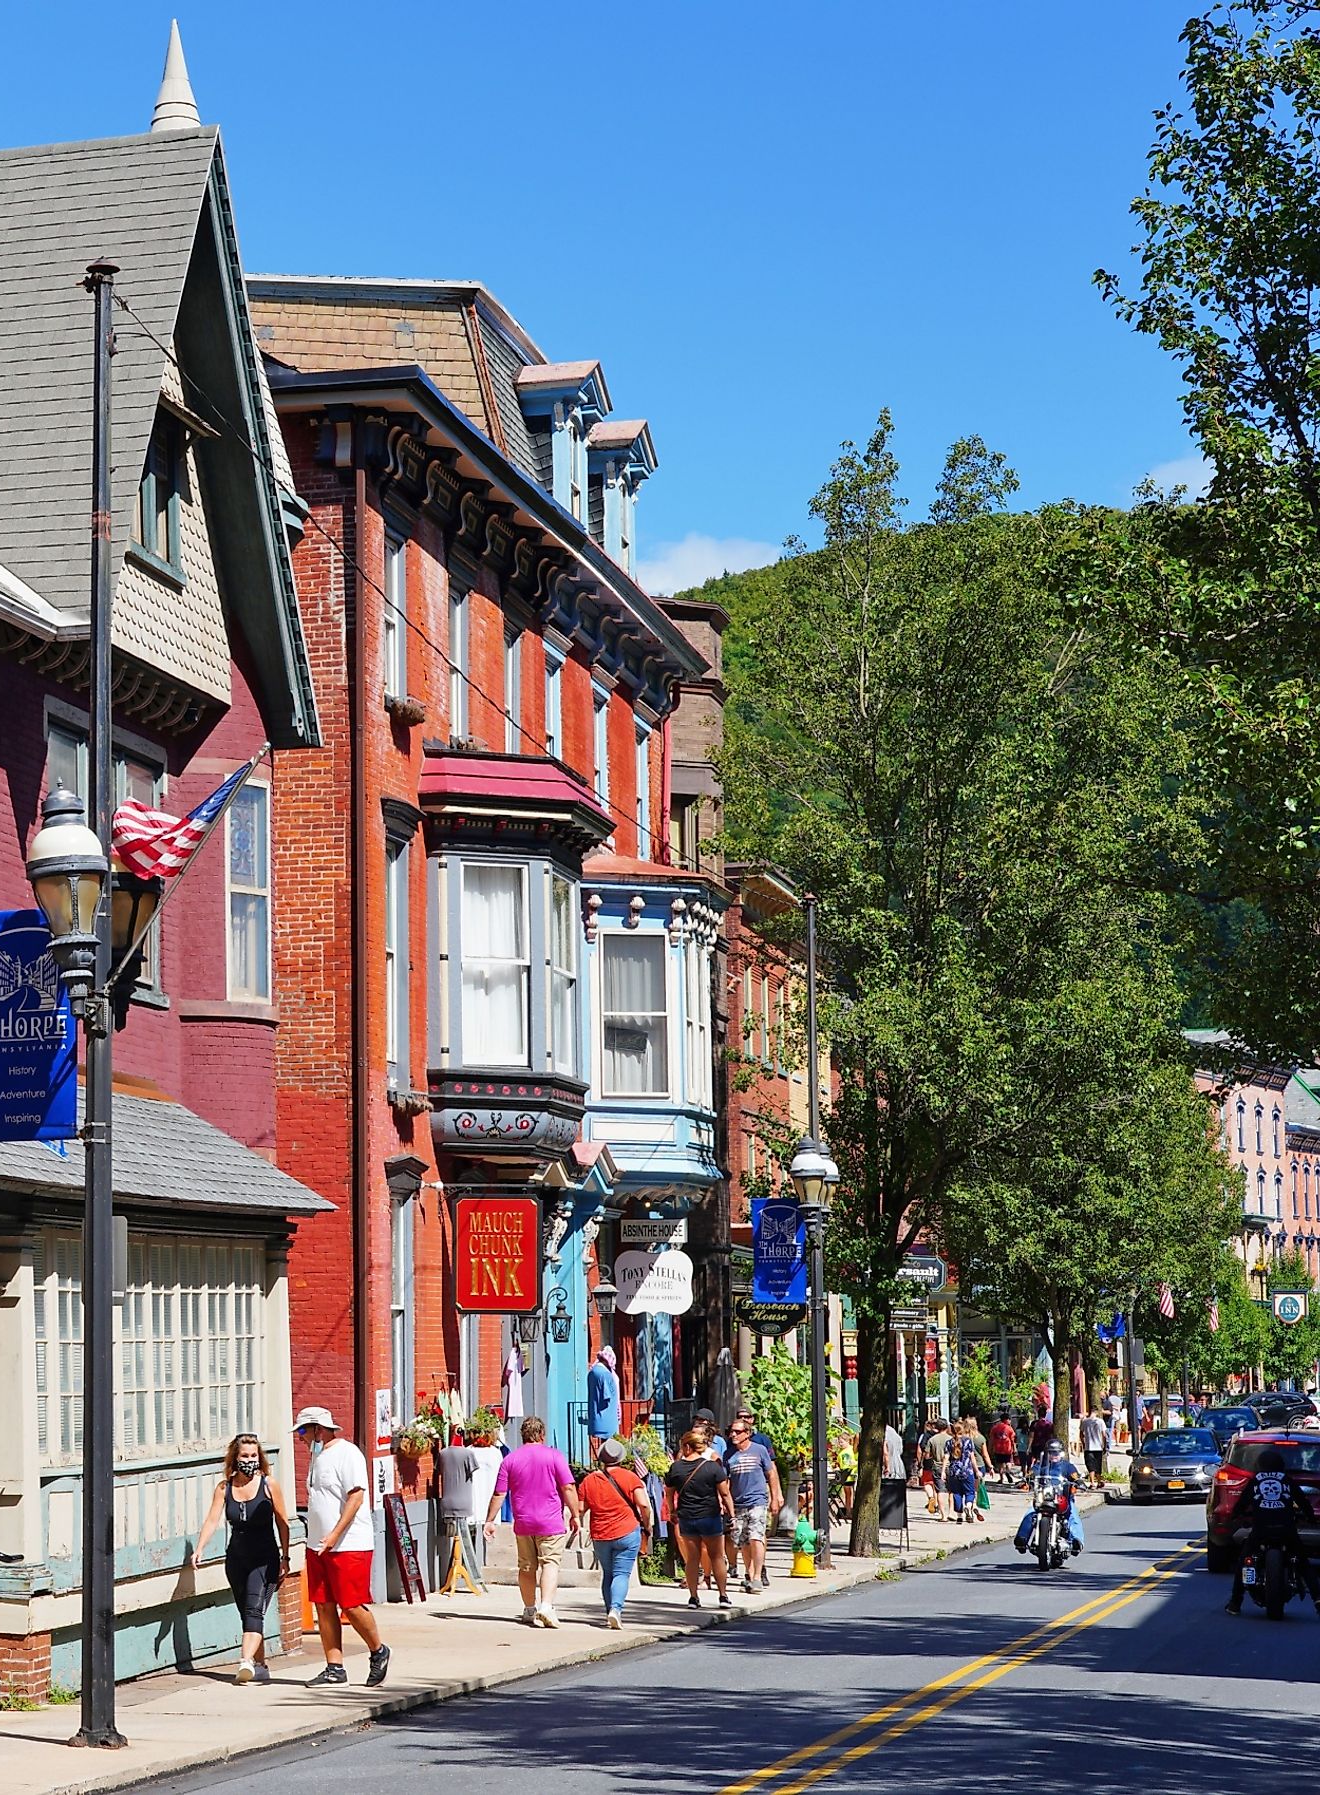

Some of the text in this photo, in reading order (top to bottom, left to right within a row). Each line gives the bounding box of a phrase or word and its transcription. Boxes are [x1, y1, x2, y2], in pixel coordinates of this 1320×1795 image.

[8, 1066, 37, 1076] History
[0, 1089, 46, 1100] Adventure
[4, 1113, 41, 1124] Inspiring
[469, 1211, 524, 1233] MAUCH
[622, 1224, 684, 1238] ABSINTHE HOUSE
[469, 1234, 524, 1256] CHUNK
[758, 1241, 768, 1249] JIM
[760, 1242, 802, 1259] THORPE
[470, 1257, 524, 1297] INK
[621, 1266, 645, 1283] TONY
[635, 1280, 673, 1290] ENCORE
[748, 1309, 788, 1321] House
[1280, 1305, 1300, 1314] INN
[1262, 1500, 1283, 1508] STAR
